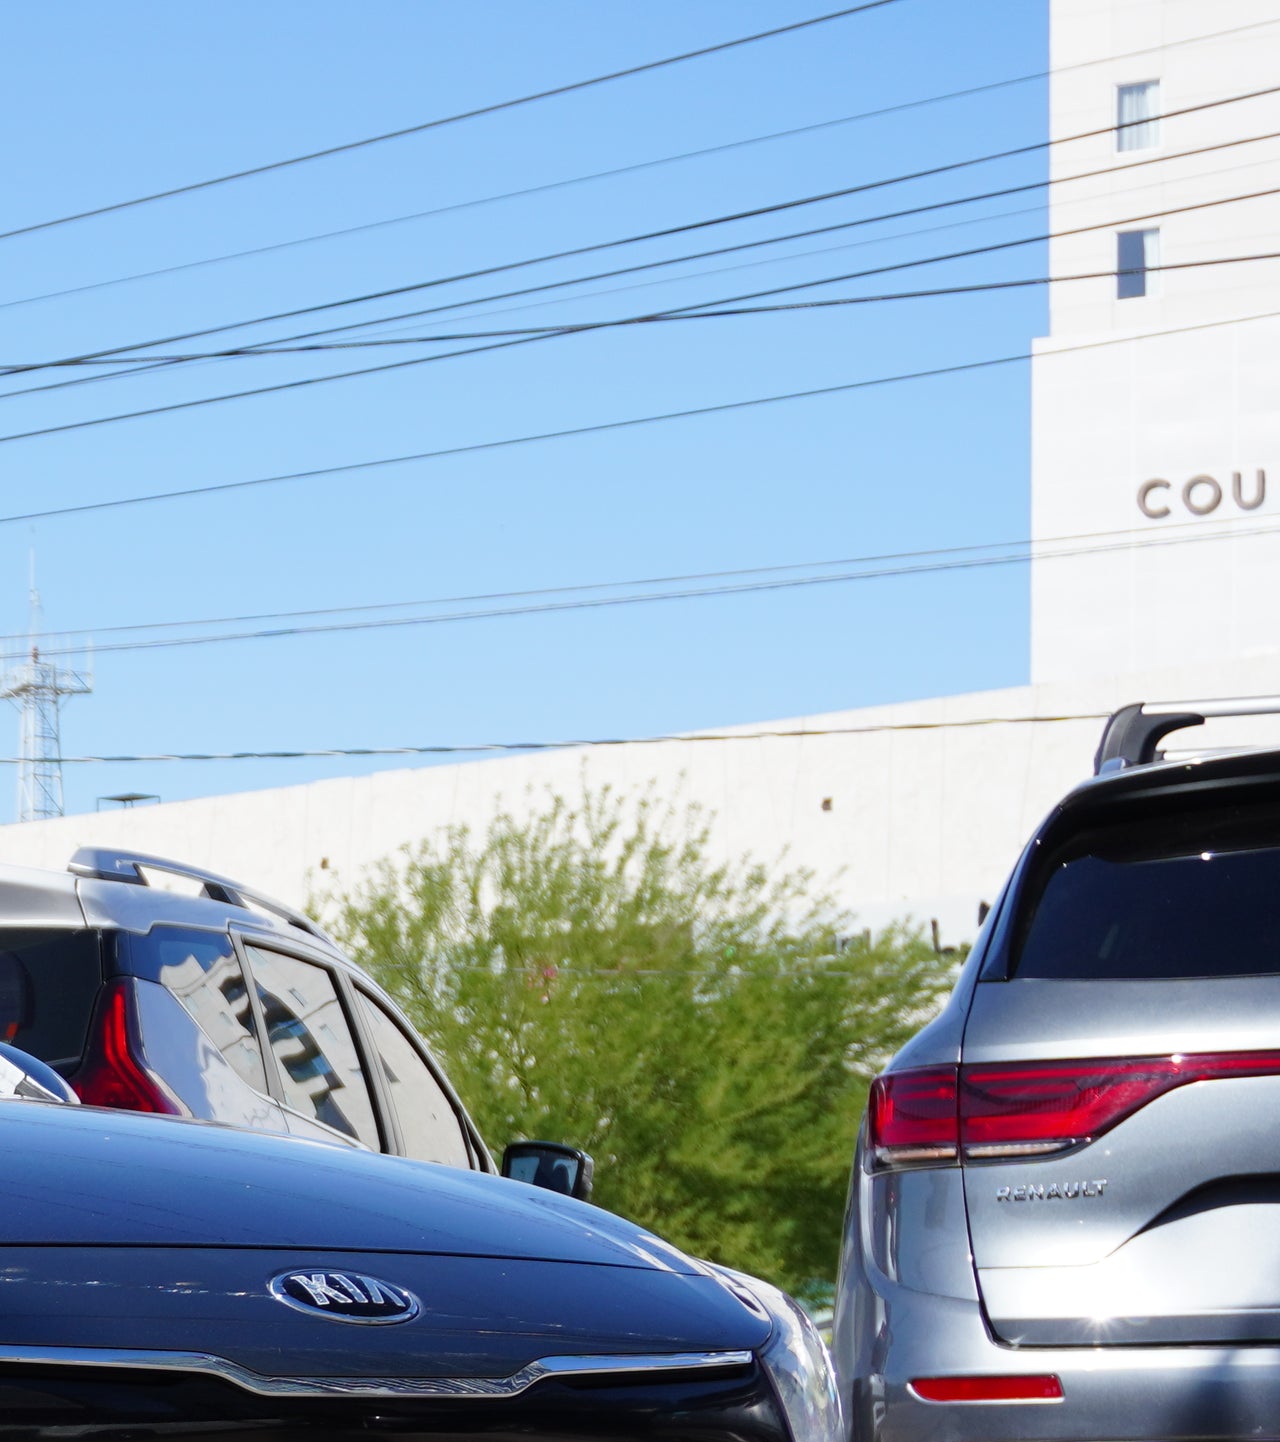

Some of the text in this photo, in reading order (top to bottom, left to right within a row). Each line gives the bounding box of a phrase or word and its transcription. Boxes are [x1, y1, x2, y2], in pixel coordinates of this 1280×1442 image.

[1136, 468, 1266, 520] COU
[996, 1178, 1108, 1202] RENAULT
[290, 1273, 407, 1308] KIA
